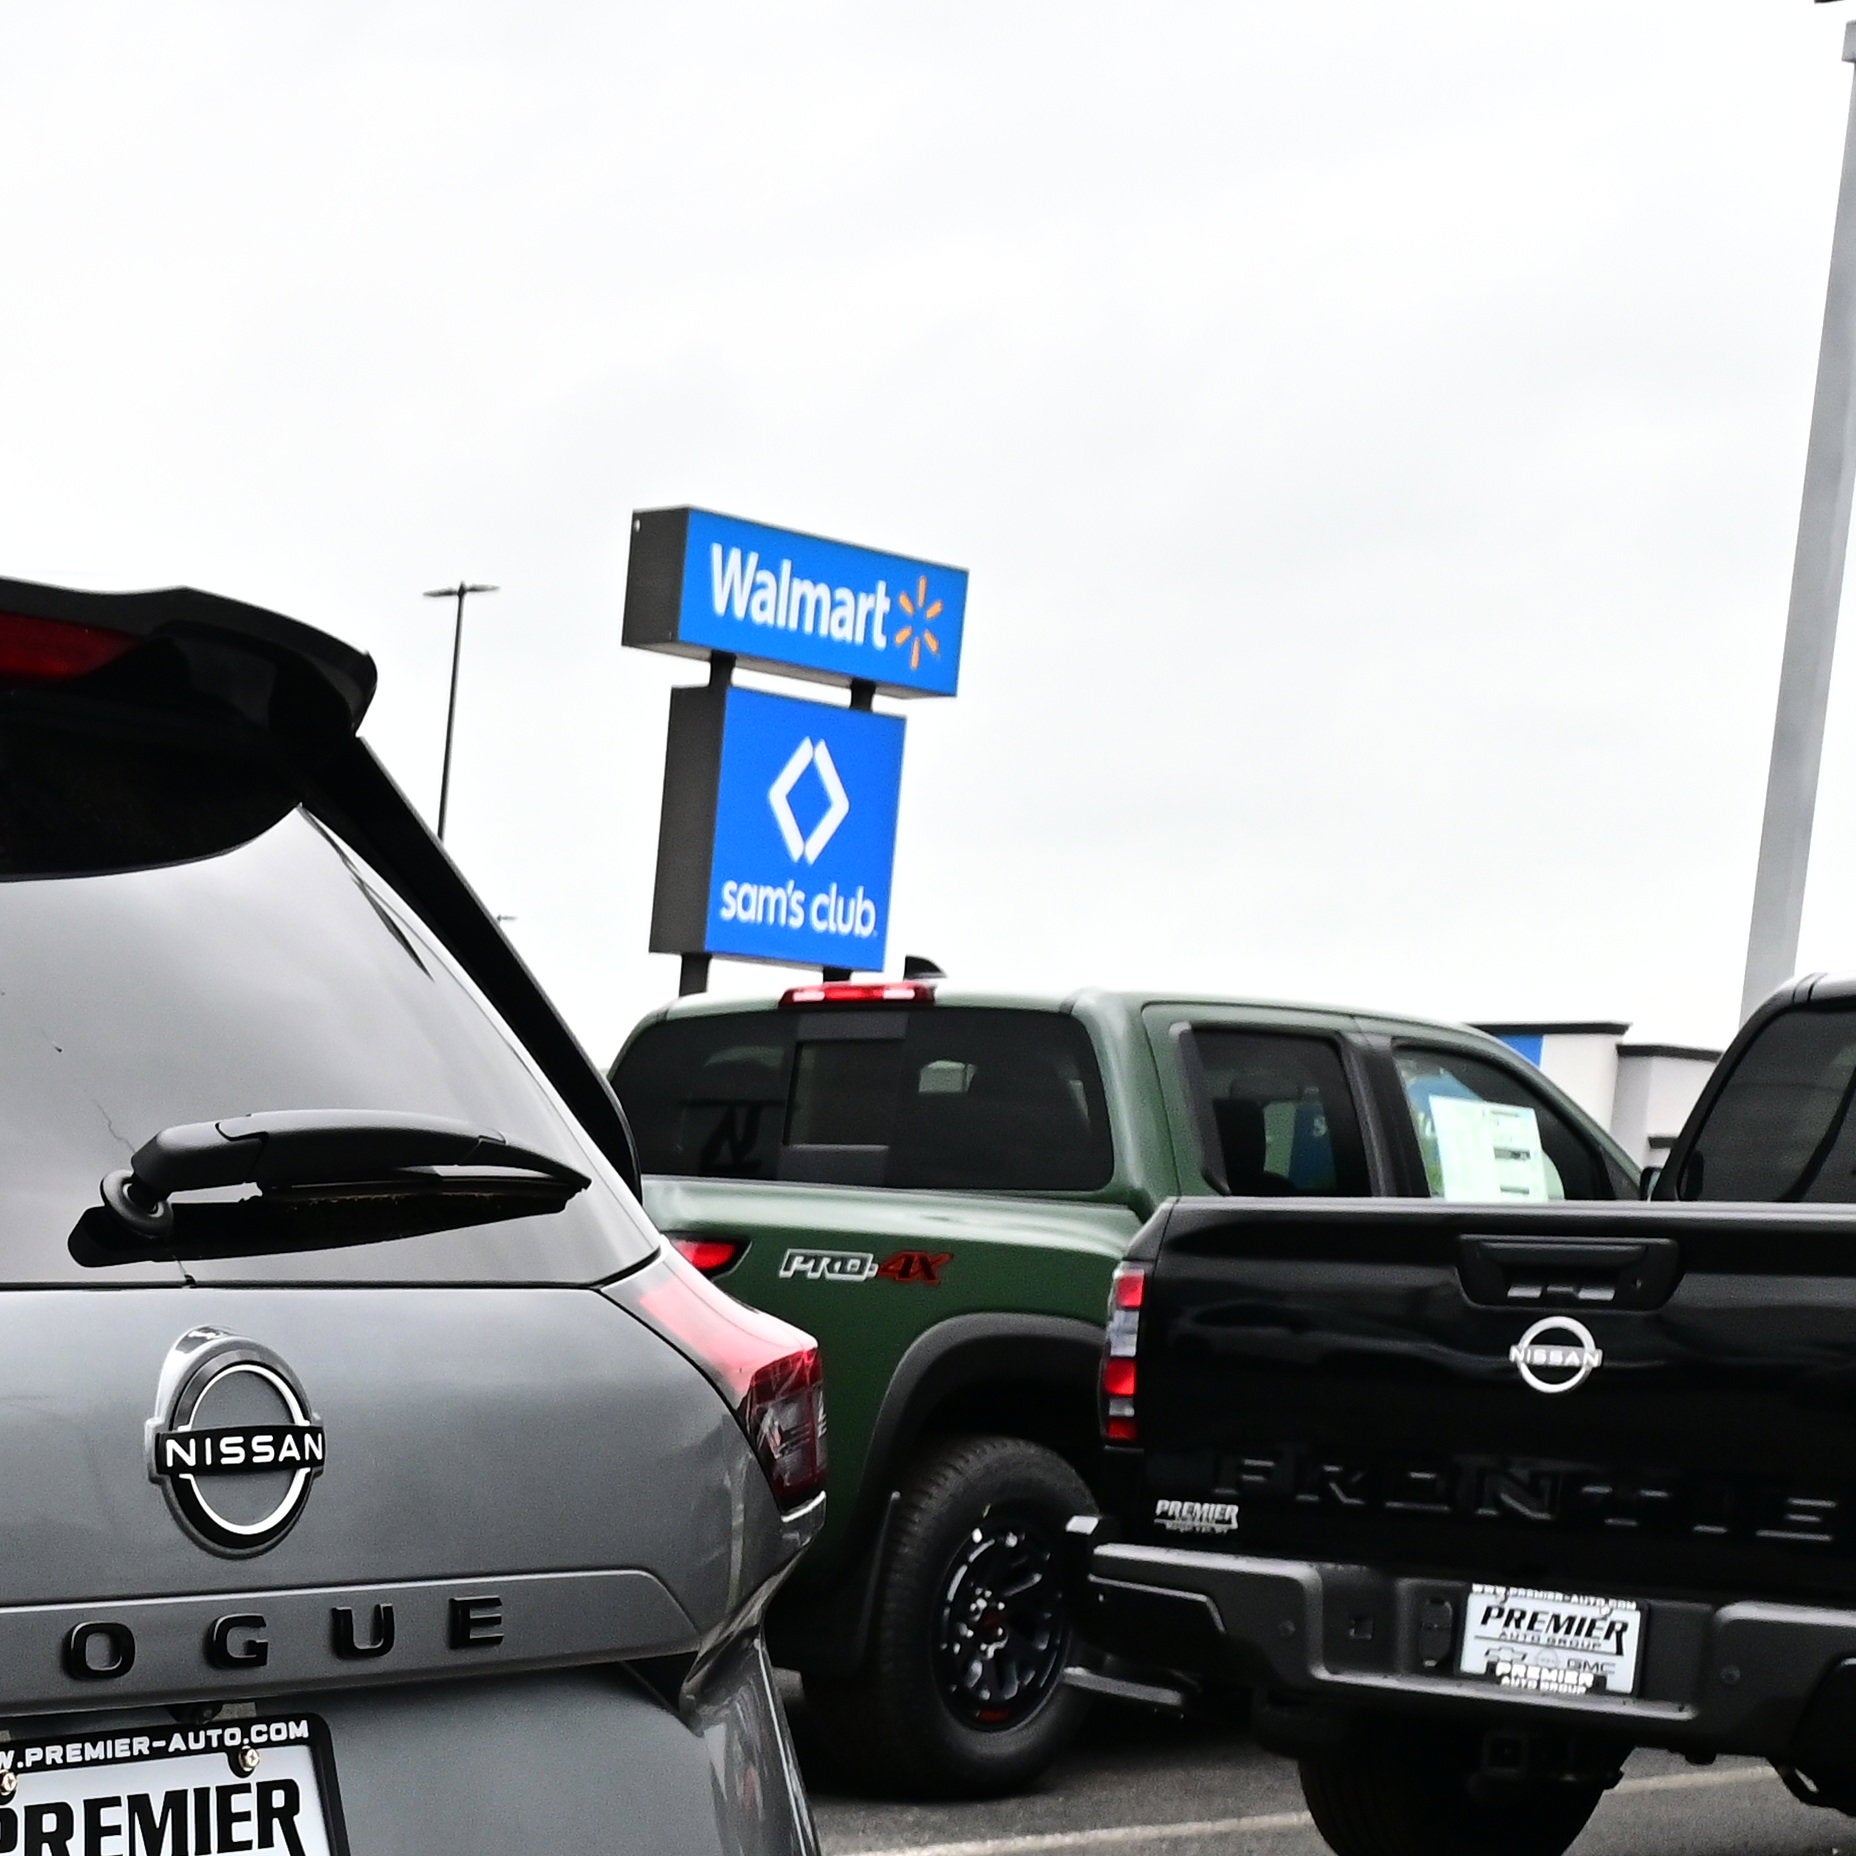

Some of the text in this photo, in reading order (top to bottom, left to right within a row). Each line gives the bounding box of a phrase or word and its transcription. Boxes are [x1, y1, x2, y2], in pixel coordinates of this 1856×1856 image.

[711, 542, 890, 651] Walmart
[720, 878, 876, 938] sam's club
[778, 1248, 955, 1285] PRO-4X
[1510, 1344, 1603, 1367] NISSAN
[165, 1432, 326, 1468] NISSAN
[1154, 1499, 1239, 1529] PREMIER
[1480, 1605, 1629, 1655] PREMIER
[1499, 1631, 1602, 1650] AUTO GROUP
[1495, 1661, 1595, 1688] PREMIER
[1567, 1658, 1616, 1675] GMC
[1500, 1676, 1538, 1690] AUTO
